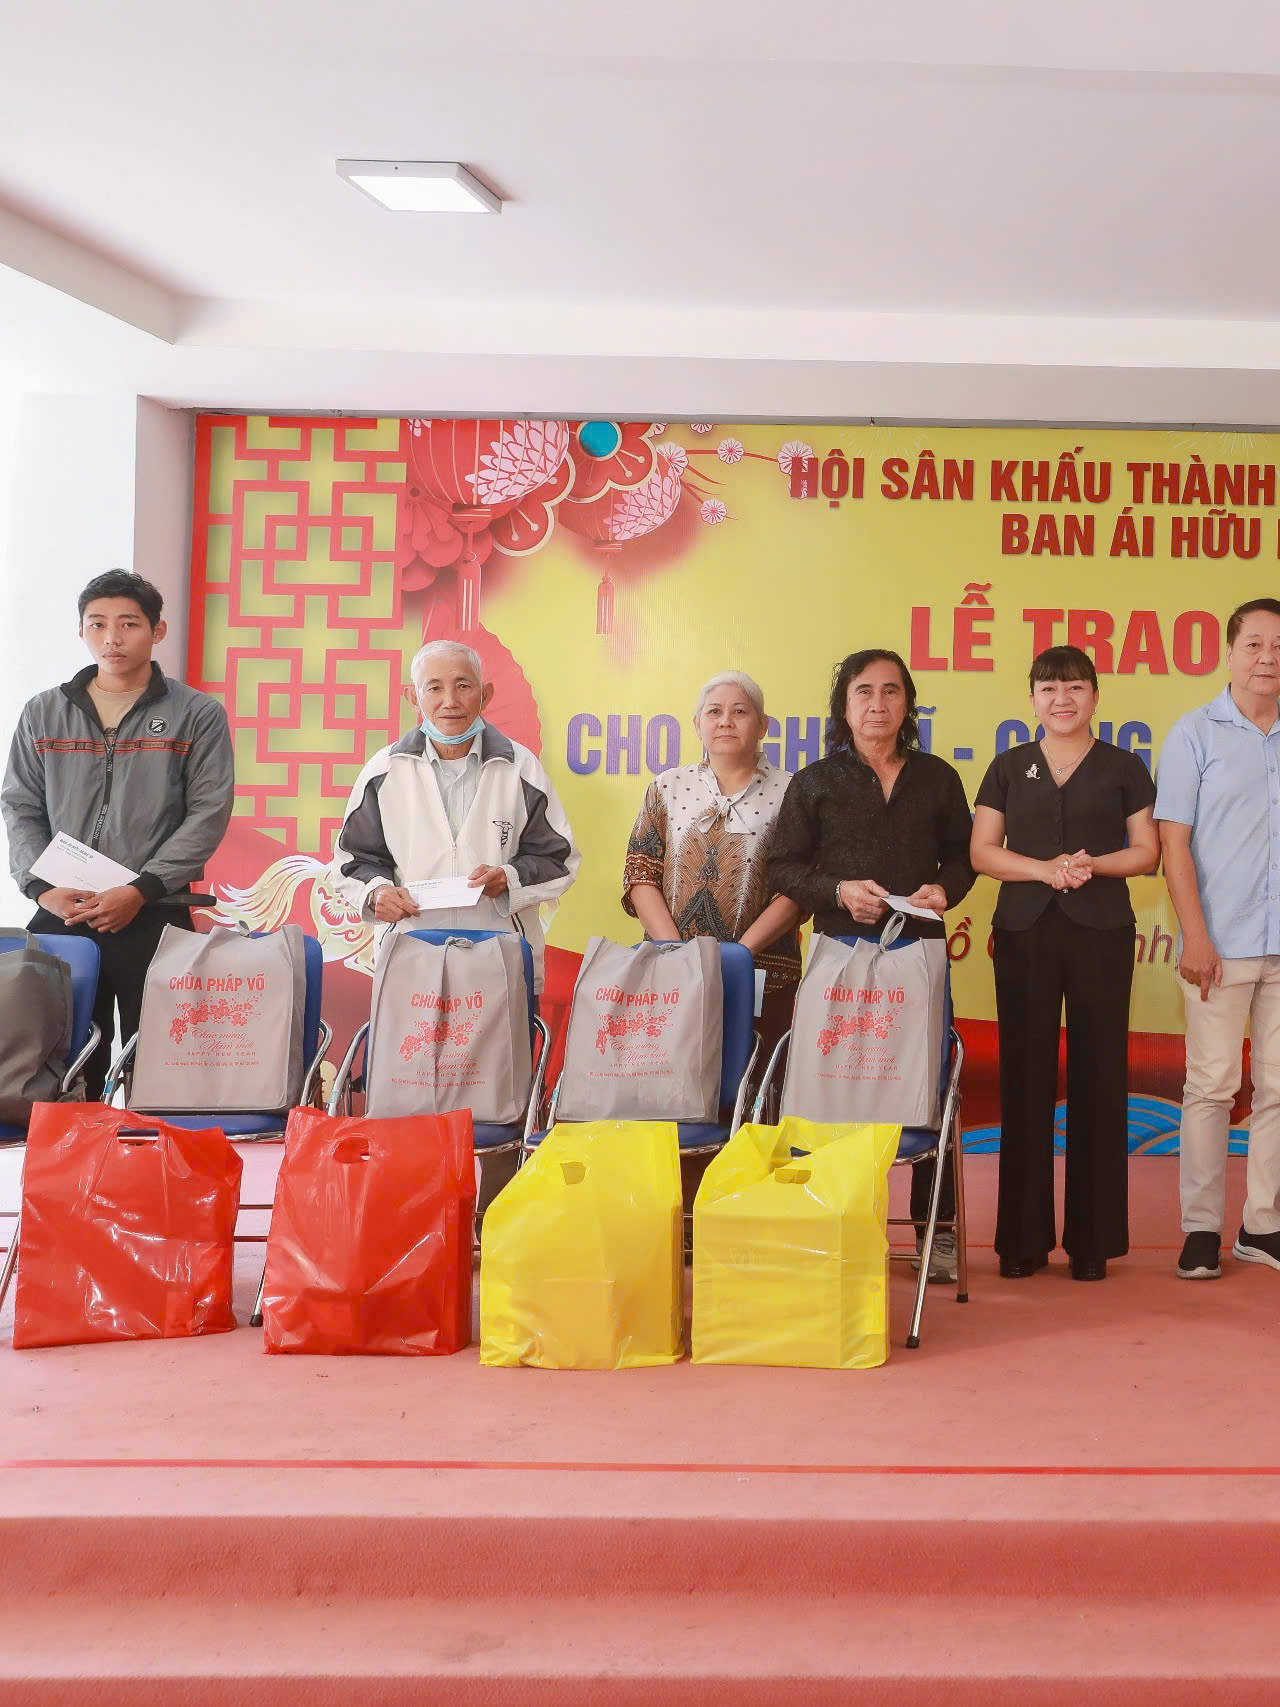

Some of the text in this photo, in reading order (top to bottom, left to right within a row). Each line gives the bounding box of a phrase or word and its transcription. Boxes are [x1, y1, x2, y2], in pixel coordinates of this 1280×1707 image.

[790, 448, 864, 508] HỘI
[881, 449, 974, 501] SÂN
[990, 446, 1111, 504] KHẤU
[1126, 455, 1276, 506] THÀNH
[1001, 512, 1095, 557] BAN
[1109, 507, 1154, 558] ÁI
[1170, 508, 1261, 560] HỮU
[910, 582, 995, 672] LỄ
[1022, 607, 1220, 676] TRAO
[566, 713, 681, 775] CHO
[953, 747, 974, 760] -
[169, 972, 265, 991] CHÙA PHÁP VÕ
[411, 991, 443, 1010] CHÙA
[465, 991, 483, 1009] VÕ
[596, 984, 680, 1007] CHÙA PHÁP VÕ
[823, 984, 905, 1004] CHÙA PHÁP VÕ
